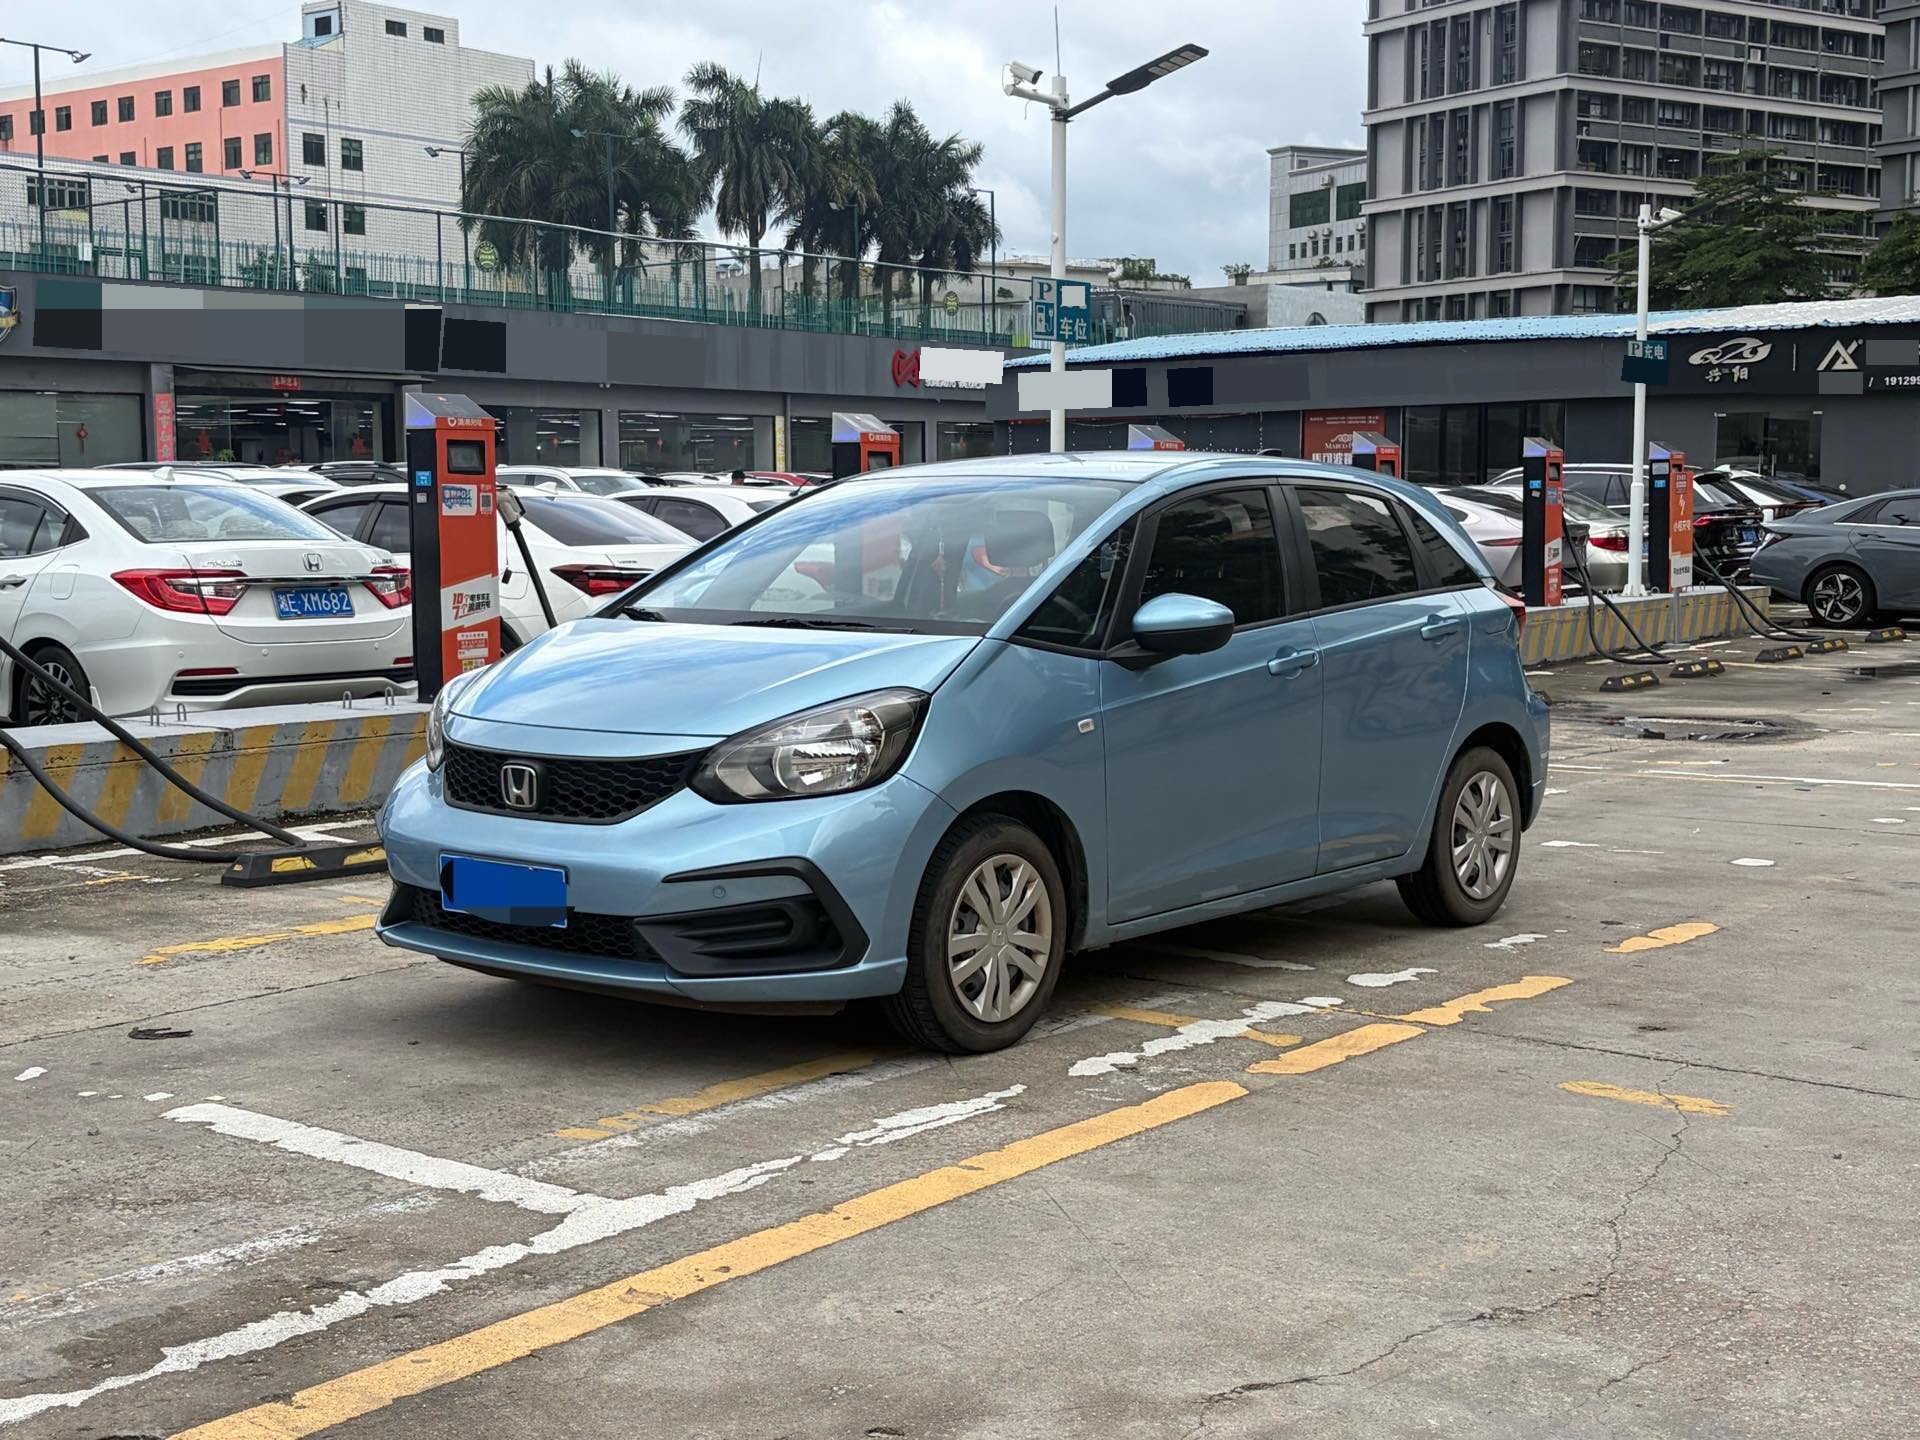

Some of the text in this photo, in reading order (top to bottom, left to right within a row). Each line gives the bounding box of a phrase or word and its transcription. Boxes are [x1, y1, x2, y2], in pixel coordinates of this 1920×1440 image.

[1038, 281, 1053, 300] P
[1059, 317, 1087, 340] 车位
[1631, 343, 1640, 356] P
[1643, 344, 1665, 360] 充电
